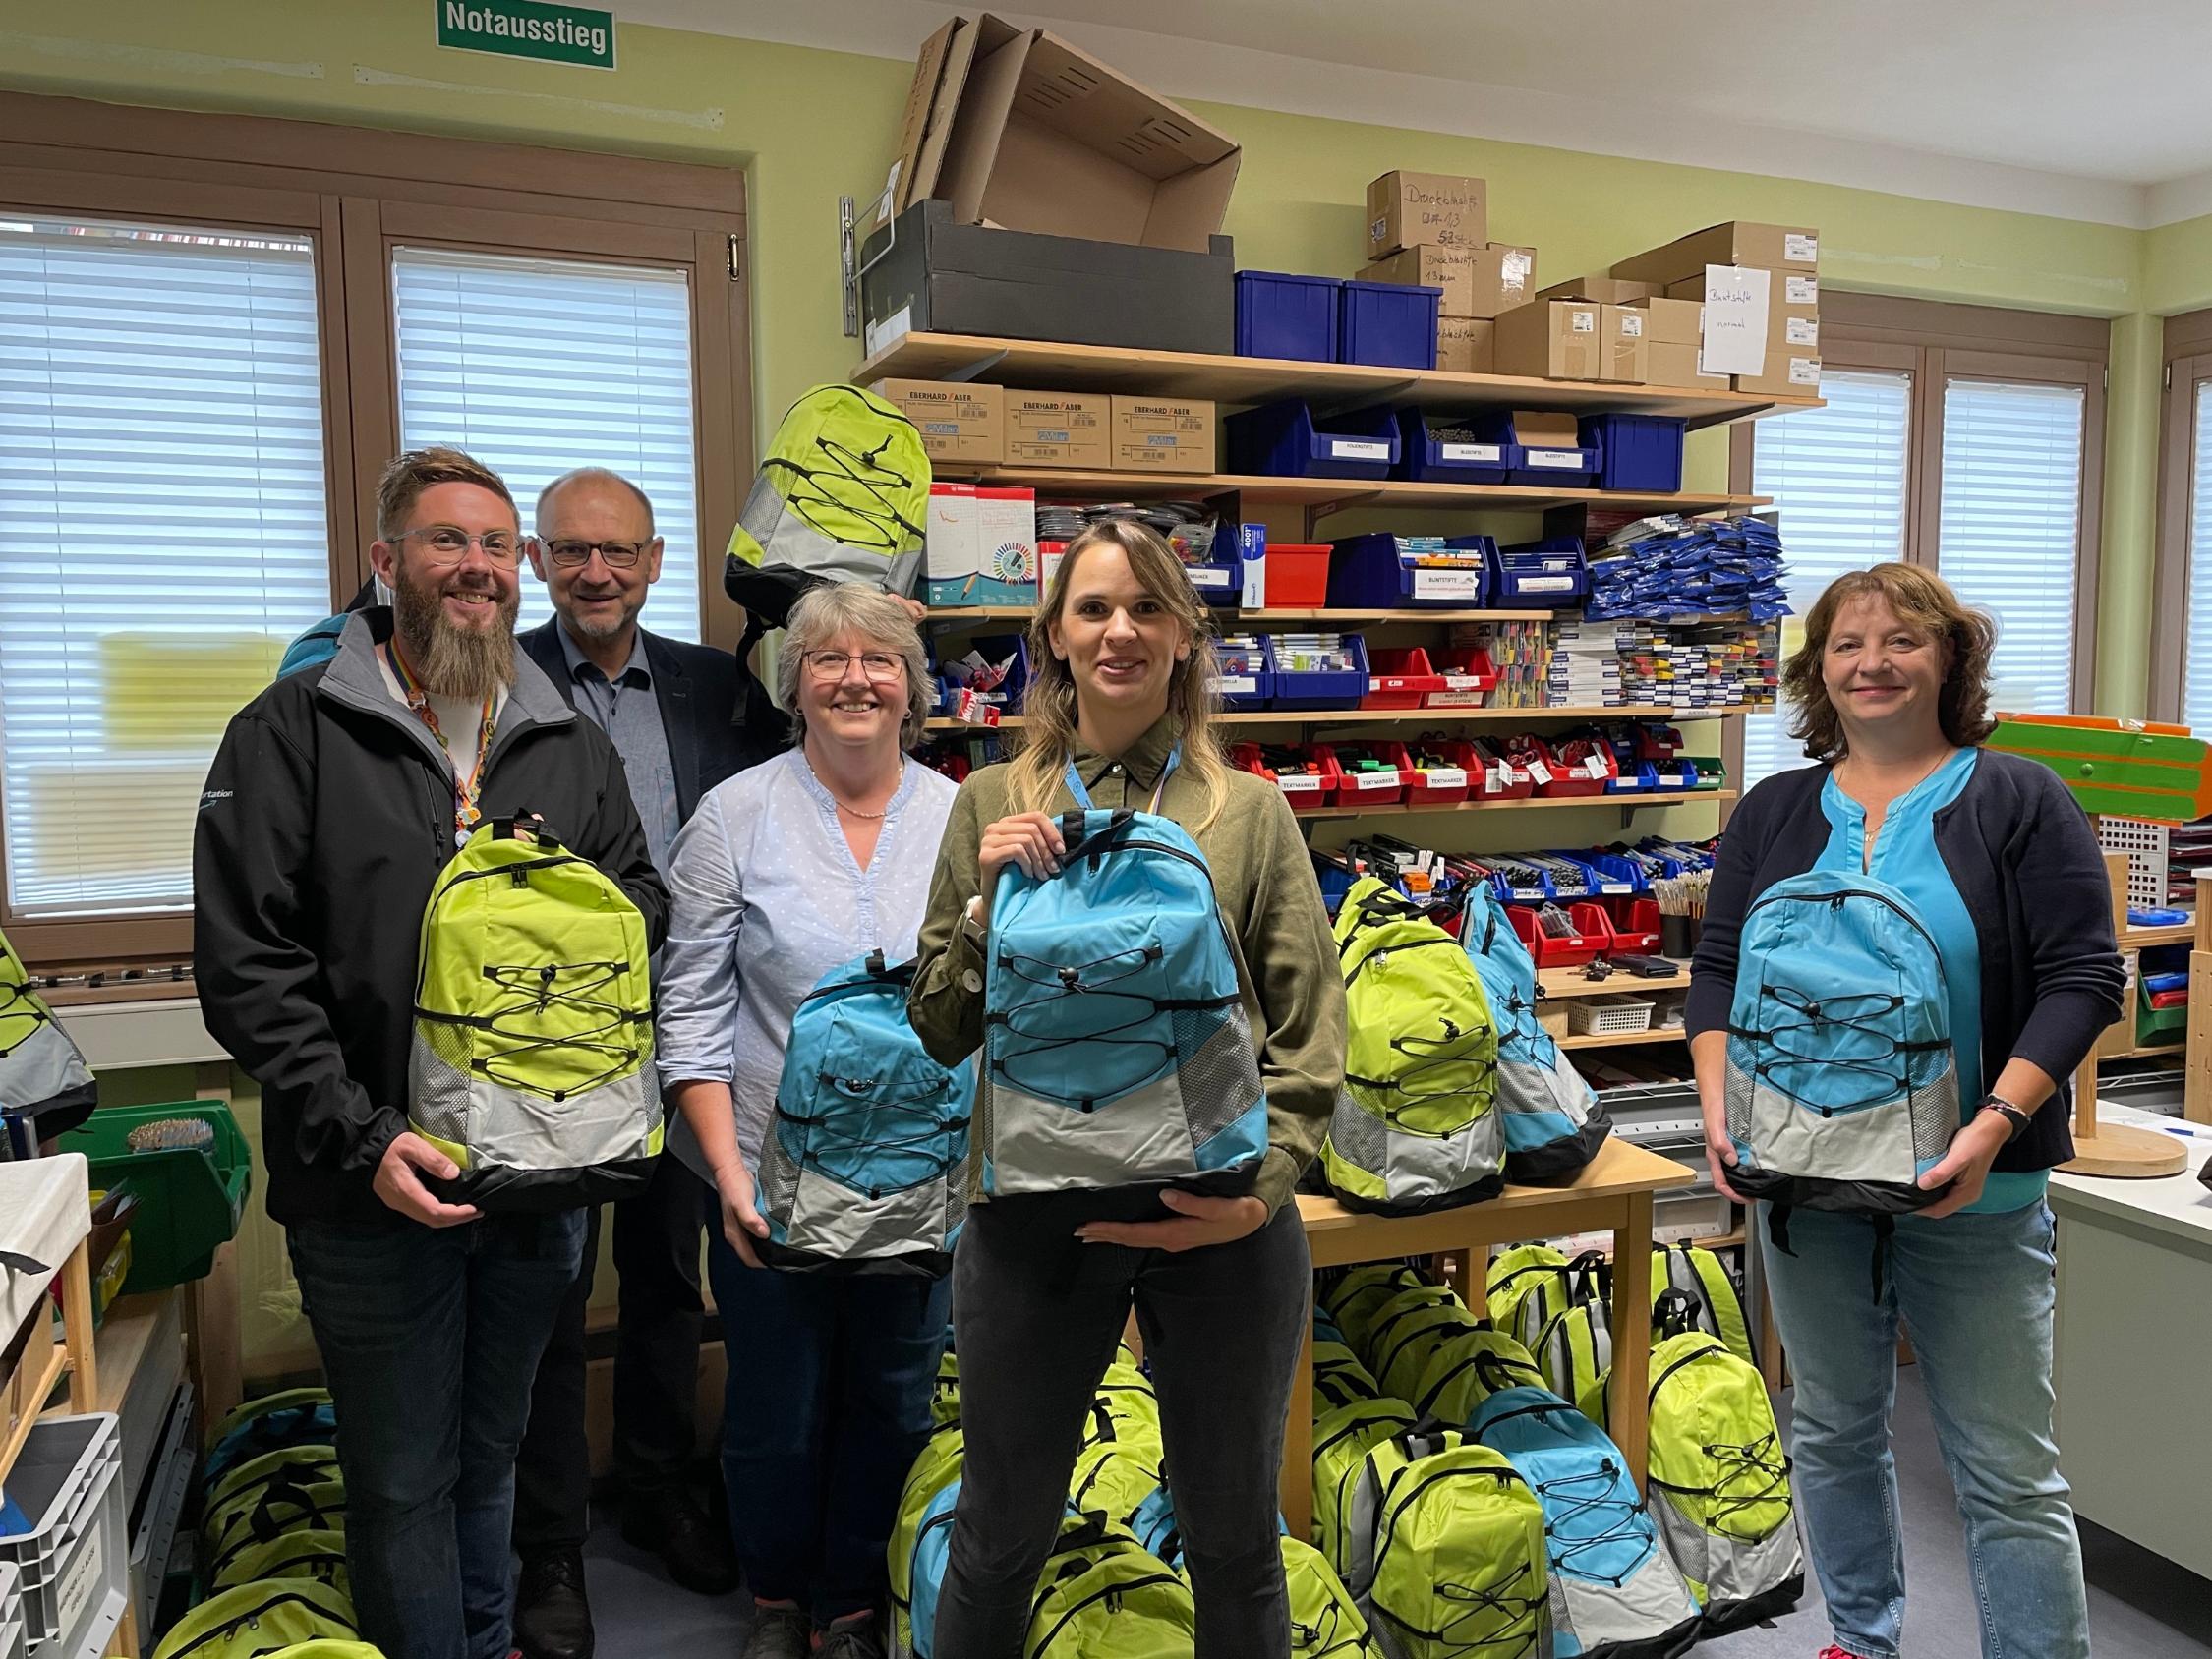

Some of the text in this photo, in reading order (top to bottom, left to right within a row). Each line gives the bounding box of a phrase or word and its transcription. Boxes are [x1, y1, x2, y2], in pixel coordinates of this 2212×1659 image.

[446, 1, 606, 55] Notausstieg
[909, 392, 947, 401] EBERHARD
[1135, 406, 1168, 415] EBERHARD
